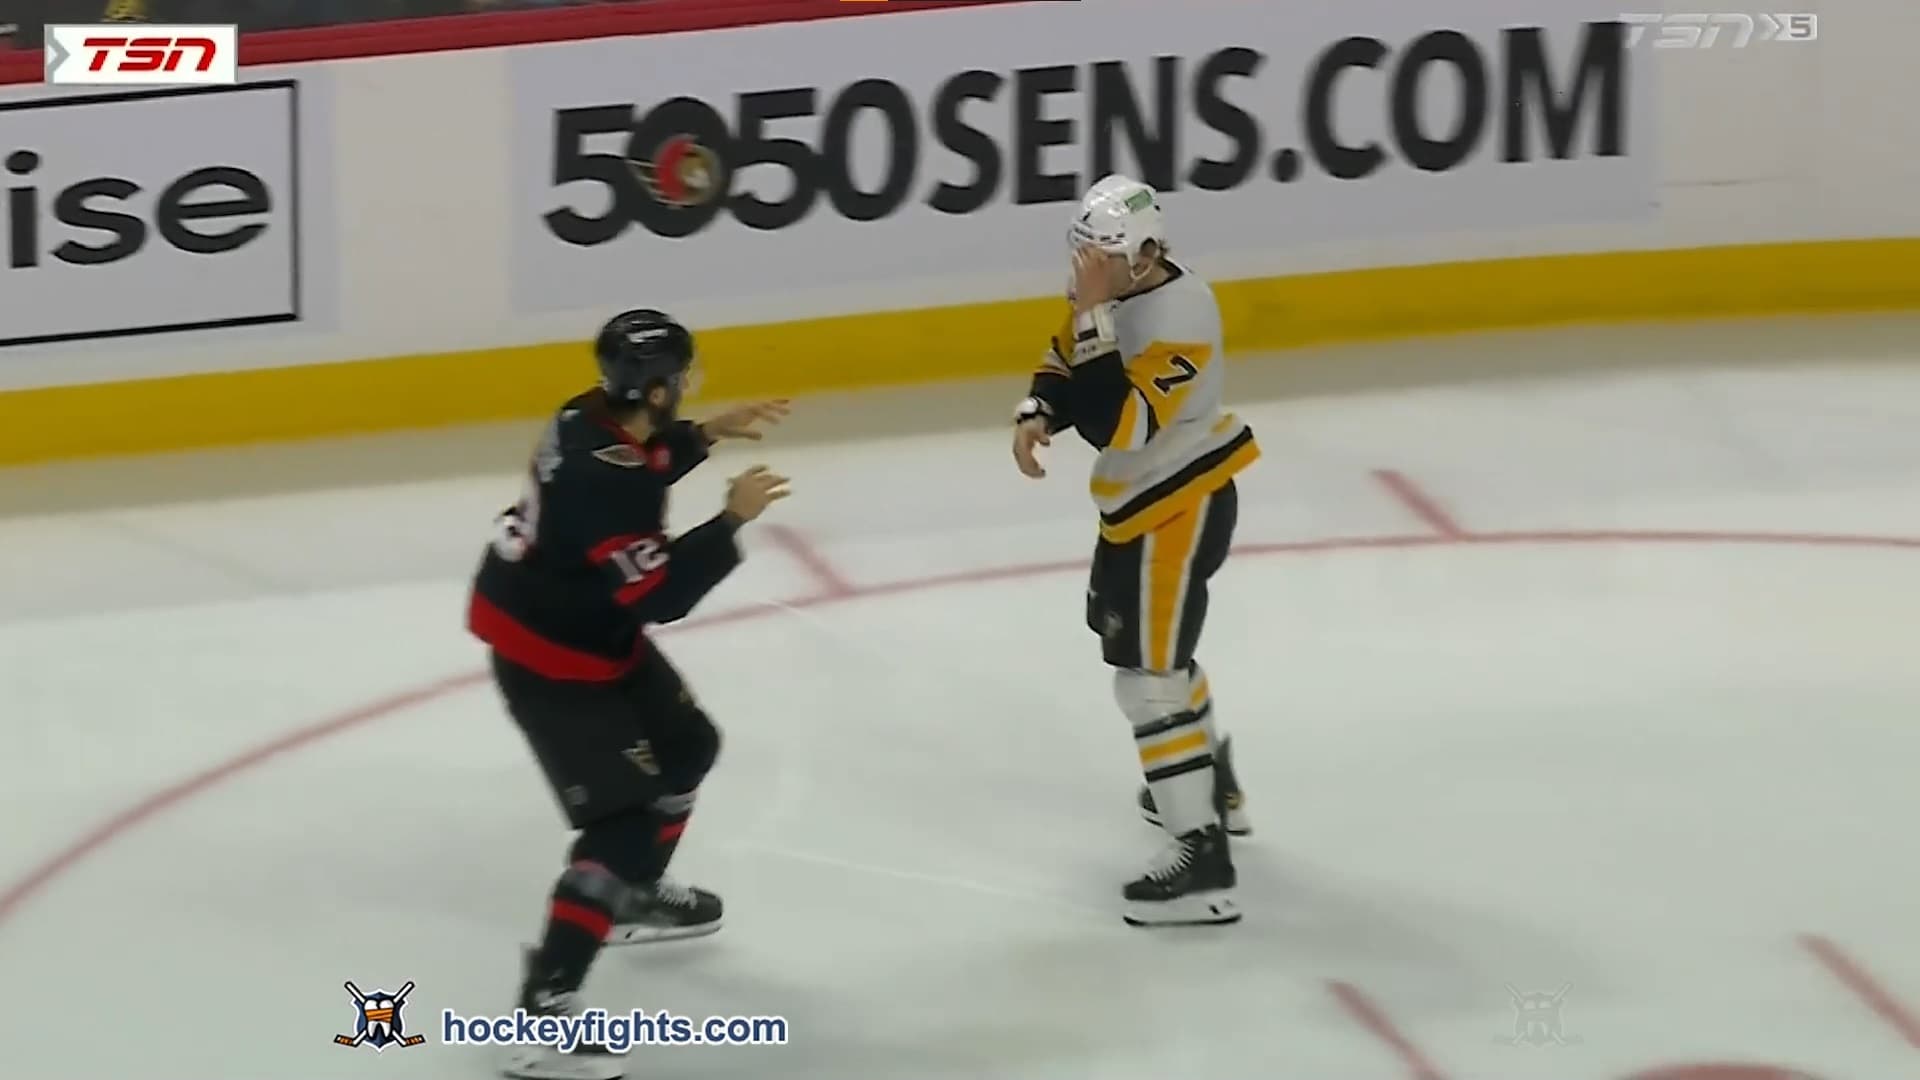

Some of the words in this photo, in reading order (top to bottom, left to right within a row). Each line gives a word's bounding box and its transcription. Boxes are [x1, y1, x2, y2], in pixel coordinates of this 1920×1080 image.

[543, 20, 1630, 246] 5050SENS.COM
[5, 150, 271, 269] ise
[1152, 353, 1199, 397] 7
[609, 538, 670, 584] 12
